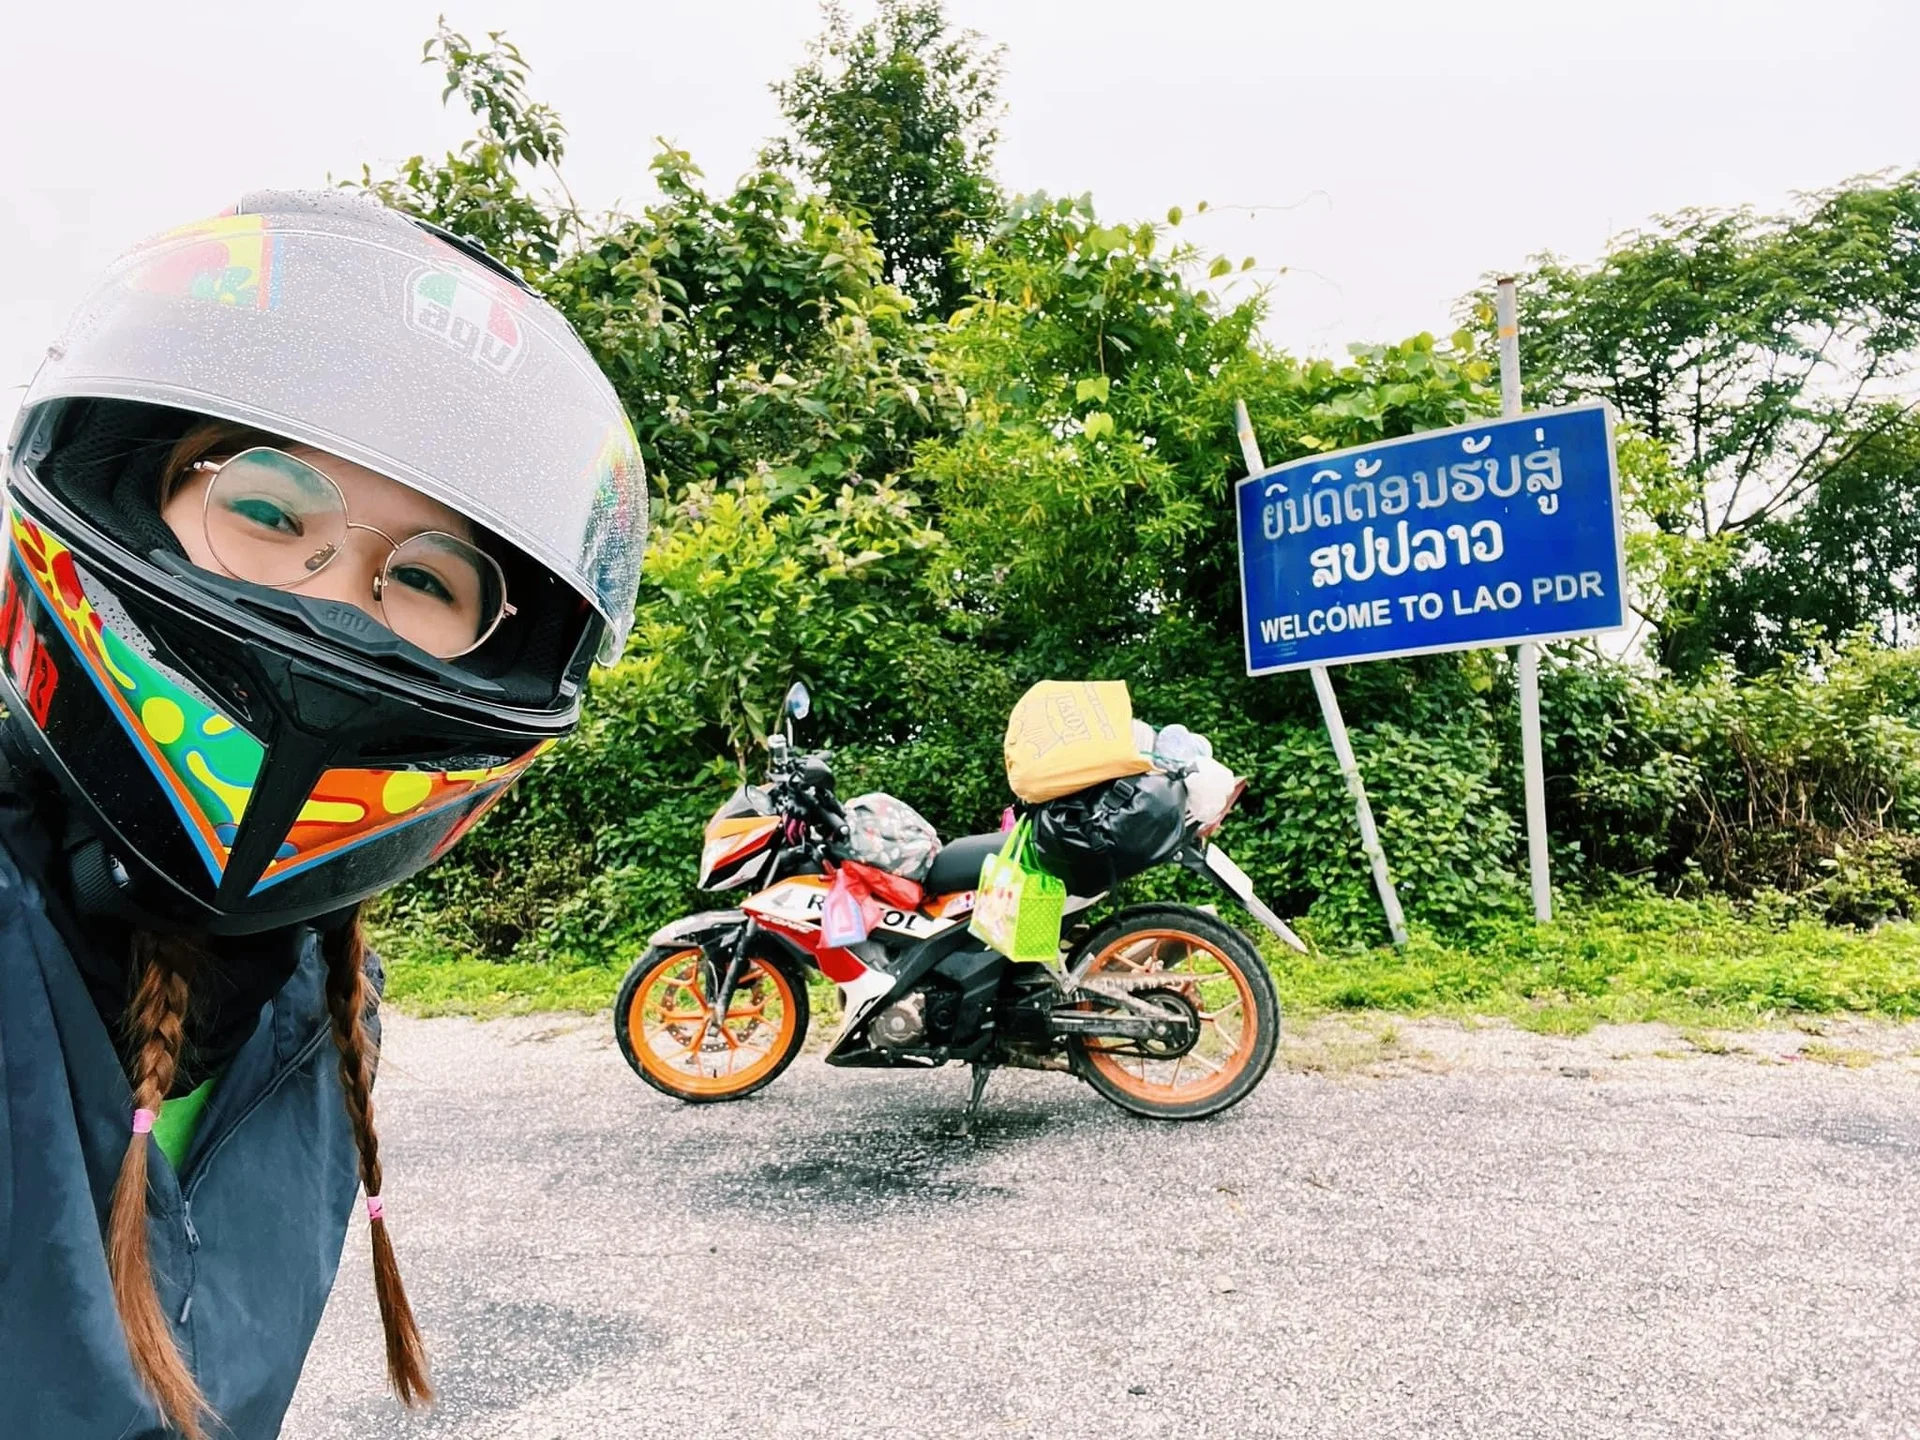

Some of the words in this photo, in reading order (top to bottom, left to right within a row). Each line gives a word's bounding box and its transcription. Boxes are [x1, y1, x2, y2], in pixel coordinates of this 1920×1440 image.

[1309, 519, 1504, 588] ສປປລາວ
[1260, 598, 1393, 644] WELCOME
[1398, 592, 1445, 622] TO
[1453, 581, 1522, 616] LAO
[1532, 571, 1605, 604] PDR
[806, 893, 918, 931] ROL
